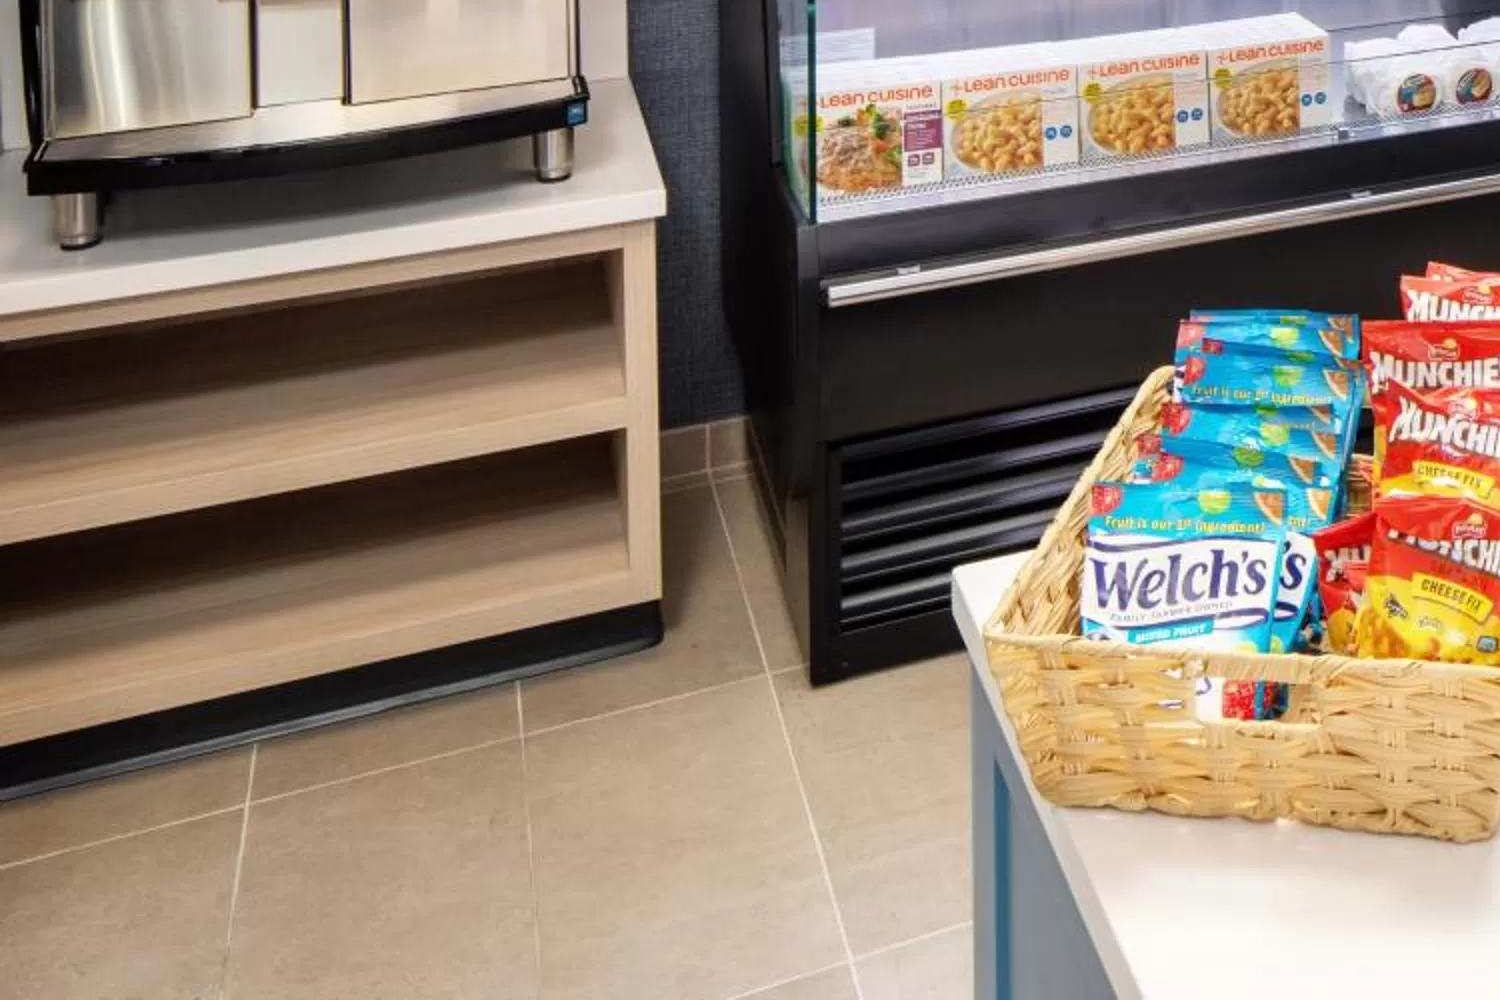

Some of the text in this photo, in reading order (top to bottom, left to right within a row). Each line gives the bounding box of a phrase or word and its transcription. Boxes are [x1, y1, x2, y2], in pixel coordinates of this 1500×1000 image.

[1099, 52, 1200, 77] Lean cuisine
[1229, 46, 1265, 63] Lean
[964, 67, 1071, 93] Lean cuisine
[820, 83, 933, 109] Lean cuisine
[1089, 548, 1268, 612] Welch's
[1420, 578, 1484, 613] CHEESE FIX
